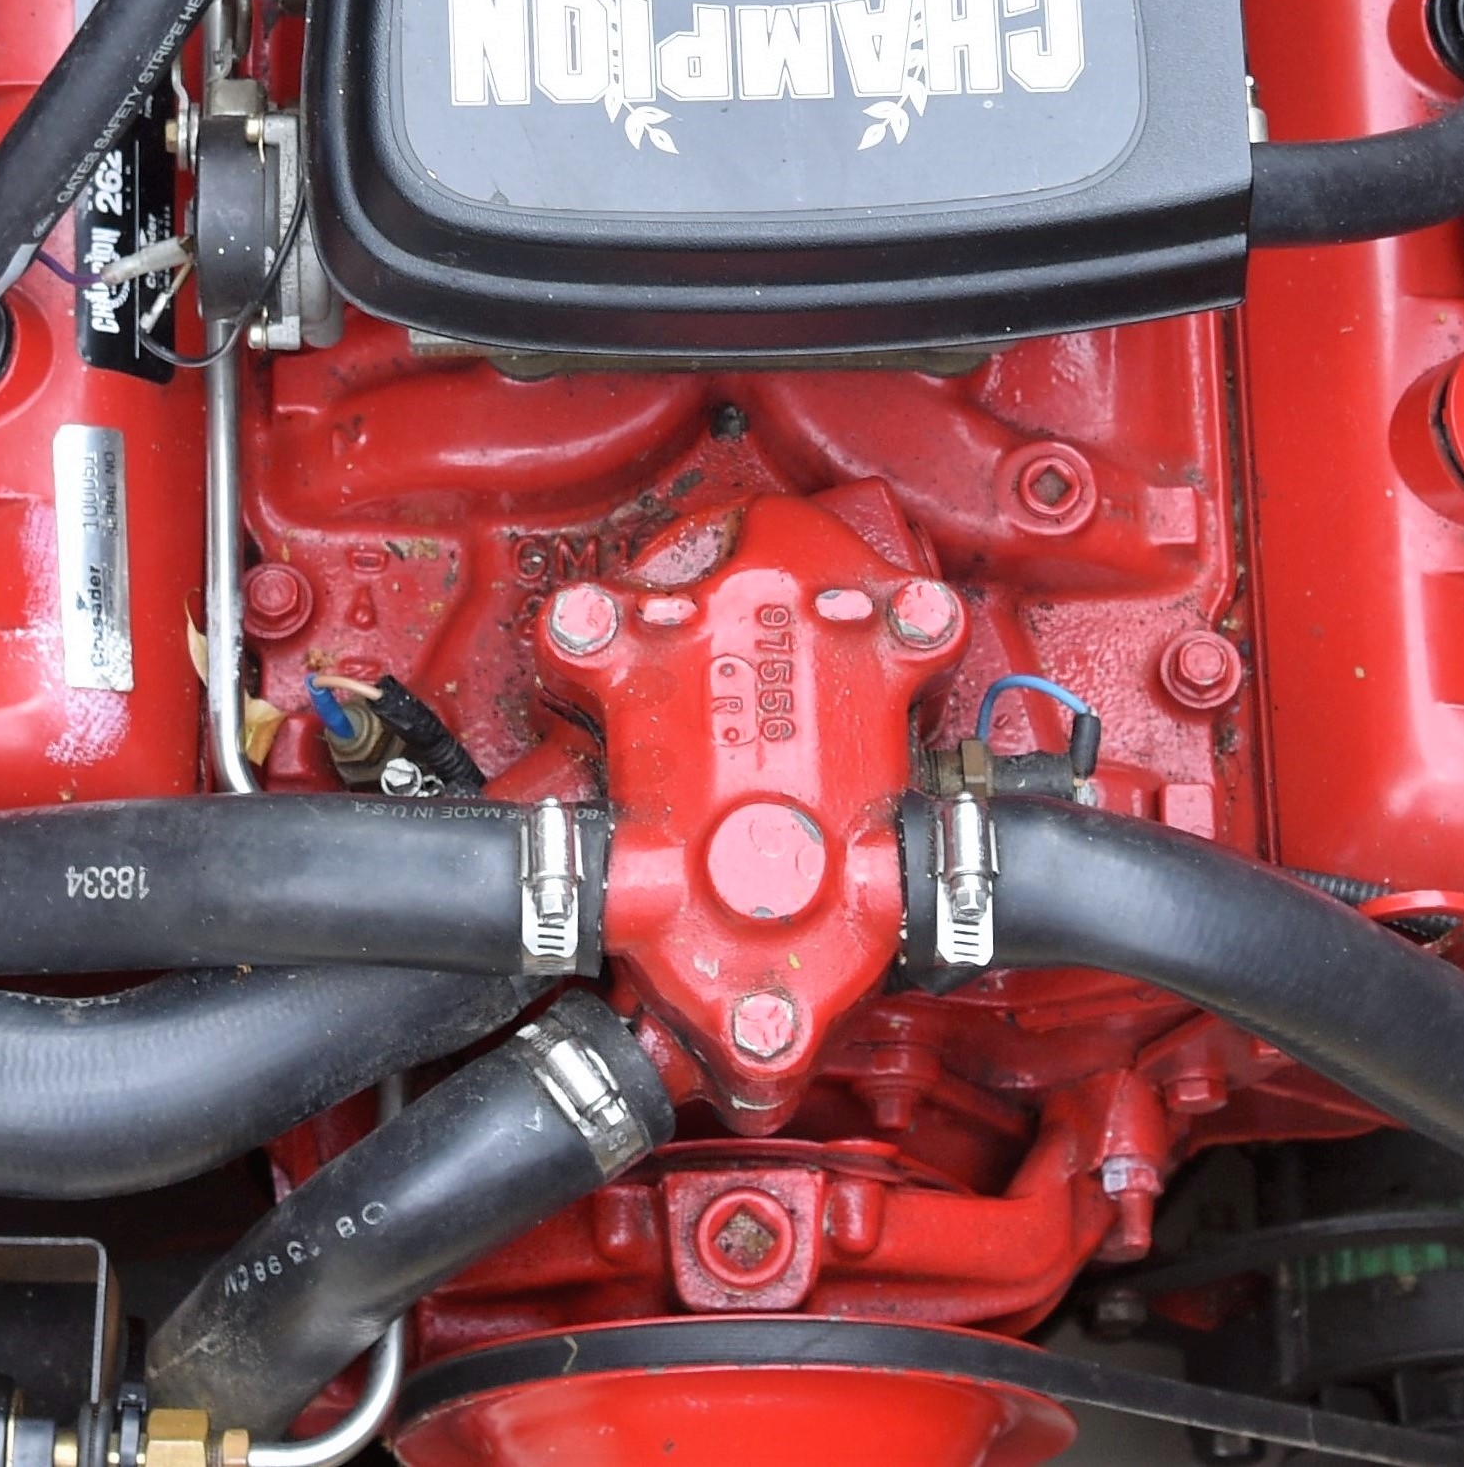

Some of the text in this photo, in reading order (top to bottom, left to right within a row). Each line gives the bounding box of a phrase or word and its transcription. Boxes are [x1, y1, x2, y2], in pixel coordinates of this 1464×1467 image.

[56, 150, 101, 204] GATES
[93, 85, 144, 150] SAFETY
[138, 17, 187, 84] STRIPE
[102, 451, 120, 538] SERIAL NO
[754, 603, 797, 743] 97556
[712, 696, 744, 714] R
[408, 805, 435, 820] IN
[441, 805, 501, 820] MADE
[64, 864, 151, 900] 18334
